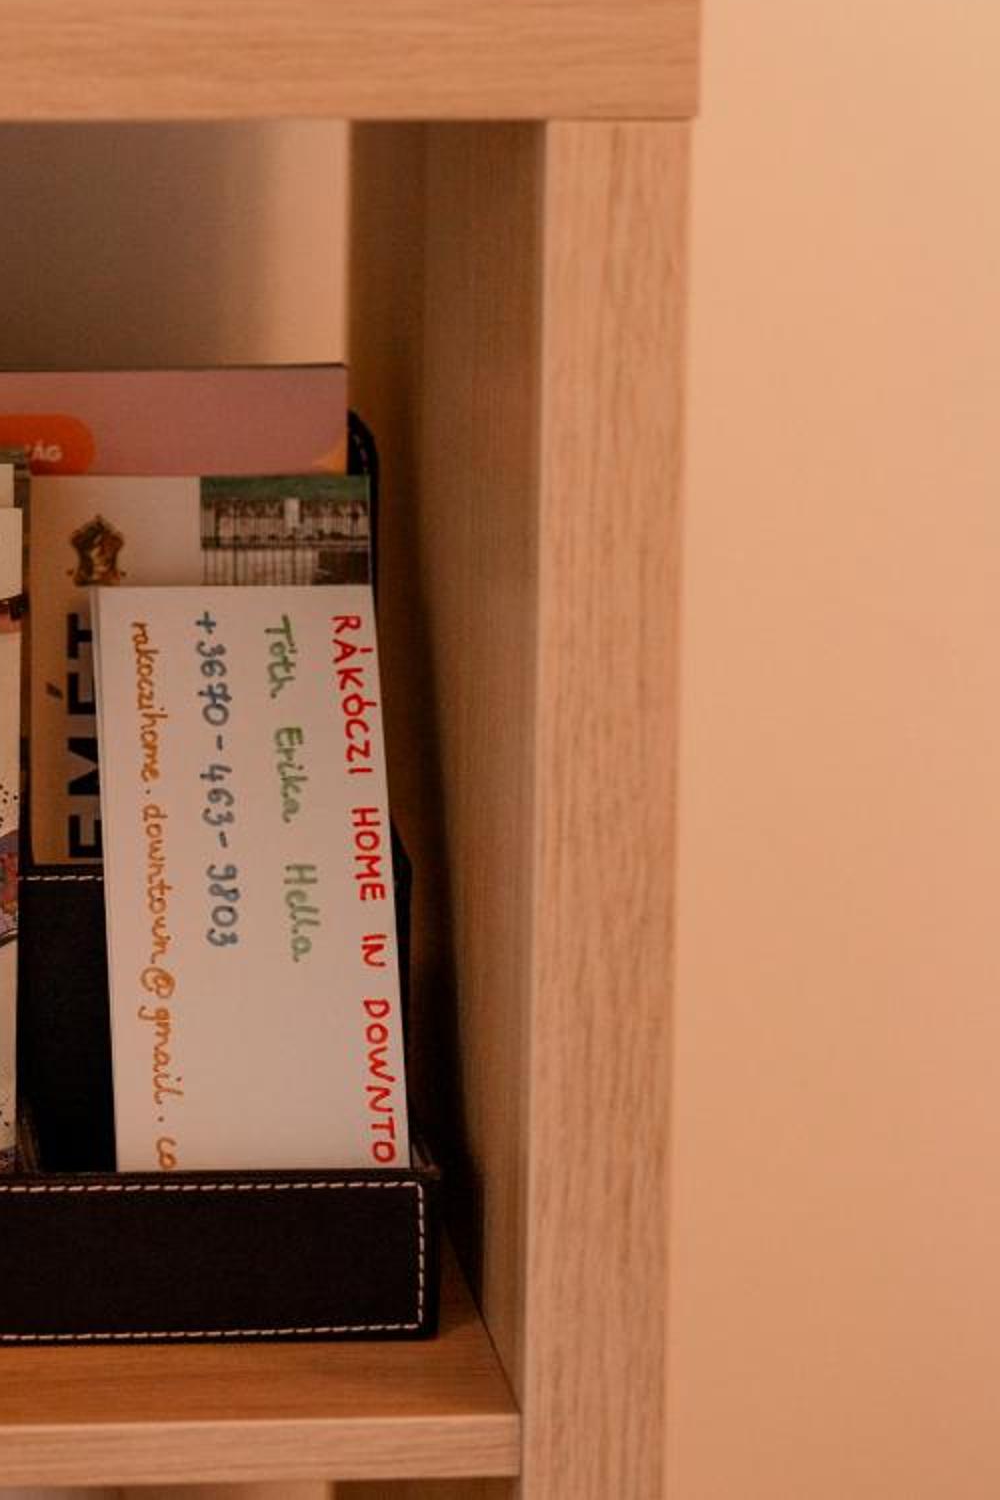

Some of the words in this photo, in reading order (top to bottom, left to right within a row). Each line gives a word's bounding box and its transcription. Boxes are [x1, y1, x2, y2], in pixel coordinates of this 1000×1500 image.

[331, 614, 377, 776] RÁKÓCZI
[274, 726, 309, 824] Erika
[351, 806, 387, 902] HOME
[282, 864, 322, 963] Hella
[360, 933, 388, 969] IN
[362, 998, 397, 1164] DOWNTO
